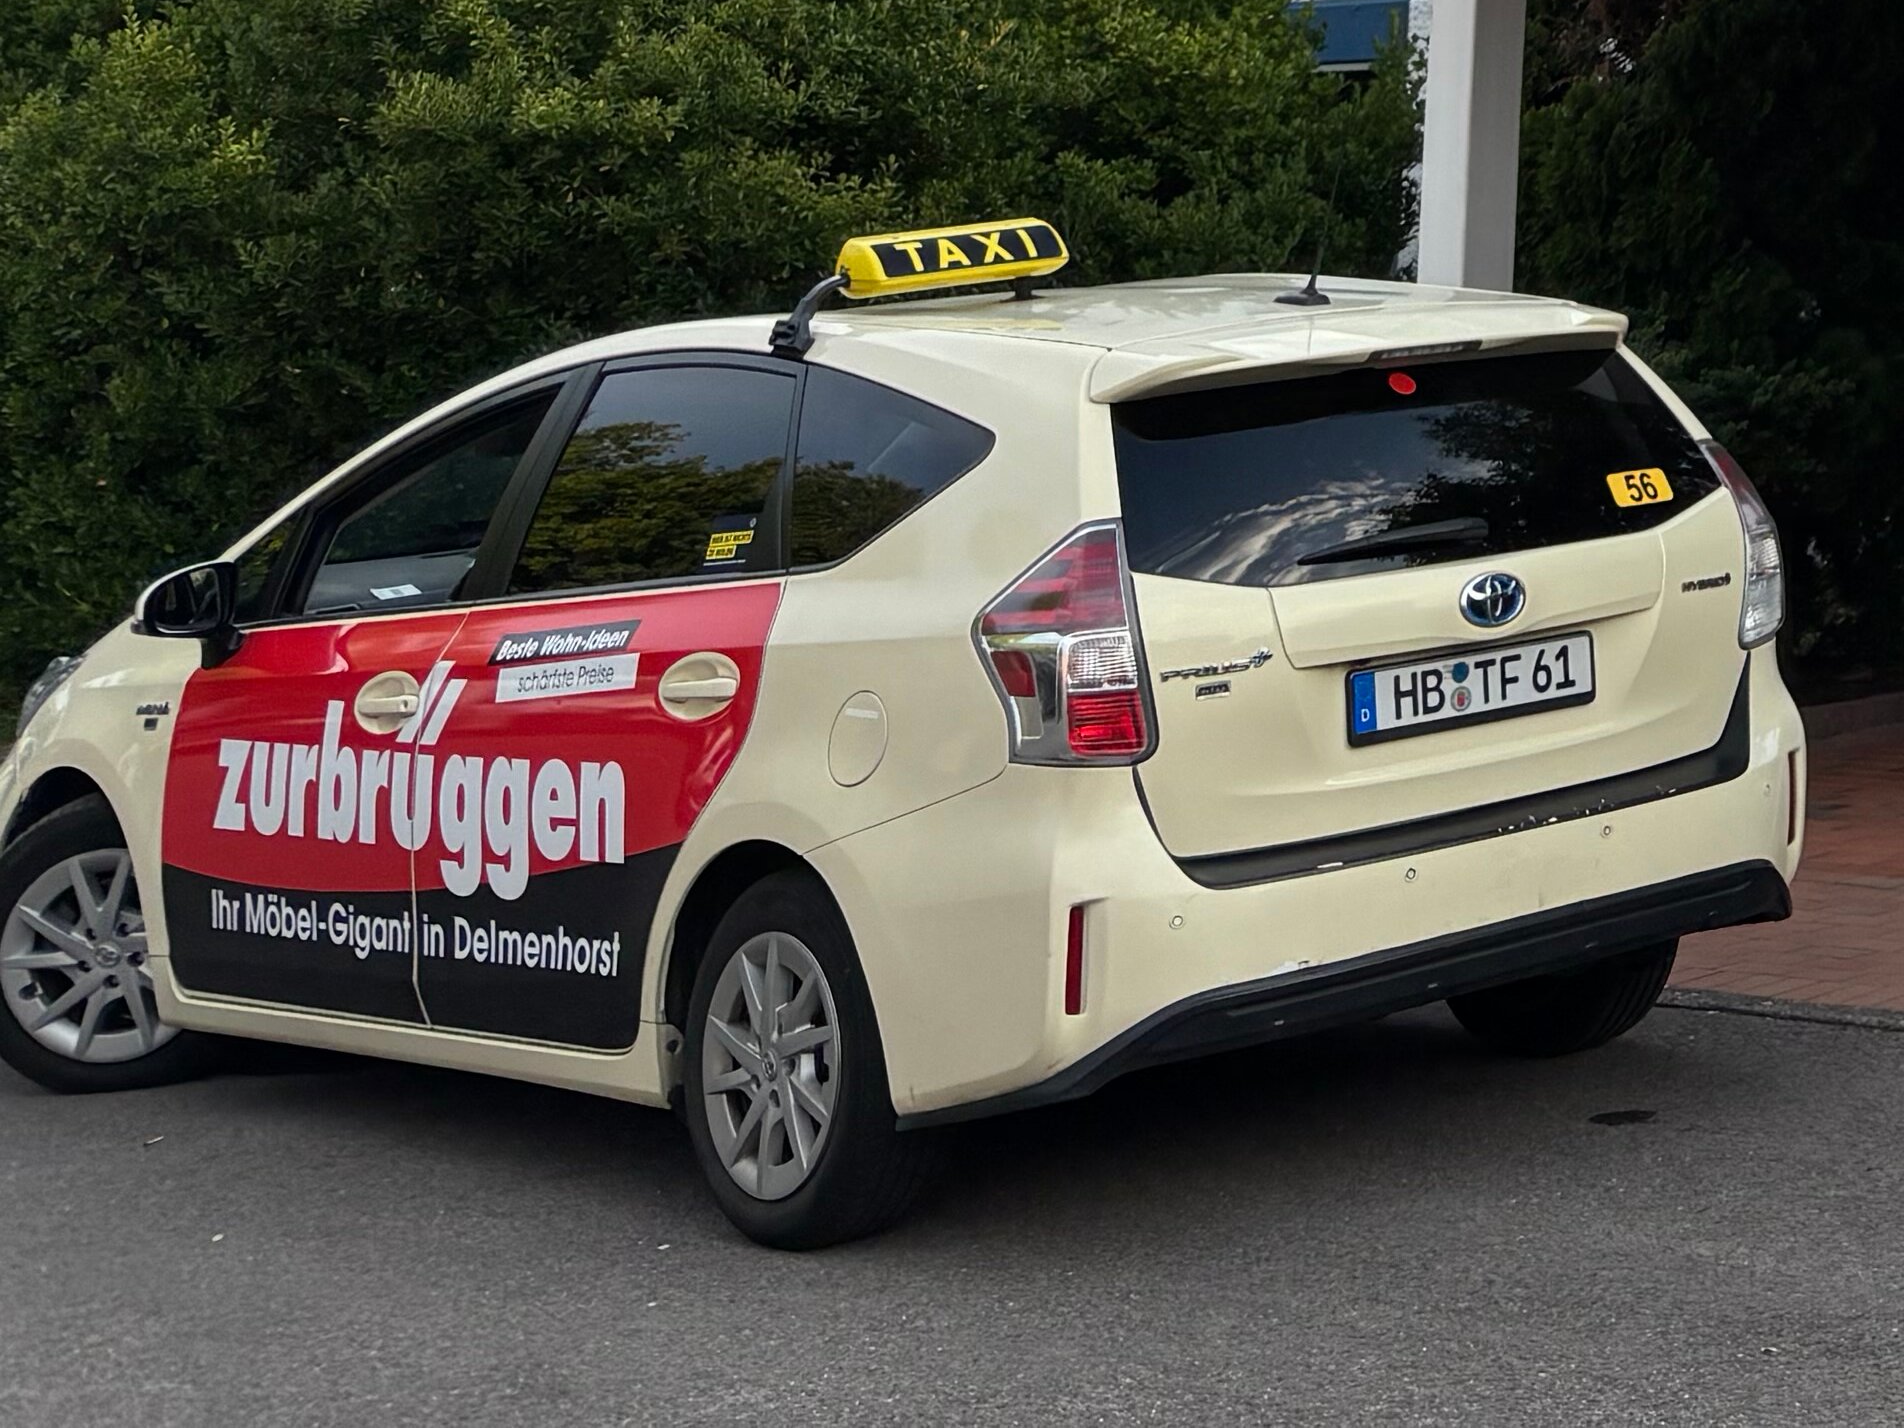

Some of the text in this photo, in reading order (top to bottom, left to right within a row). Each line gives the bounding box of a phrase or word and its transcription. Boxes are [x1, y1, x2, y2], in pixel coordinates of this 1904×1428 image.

[893, 229, 1038, 272] TAXI
[1624, 472, 1658, 502] 56
[496, 629, 631, 662] Beste Wohn-Ideen
[517, 664, 615, 693] schärfste Preise
[1361, 645, 1577, 722] D HB TF 61
[213, 660, 626, 901] zurbrüggen
[211, 889, 620, 977] Ihr Möbel-Gigant in Delmenhorst
